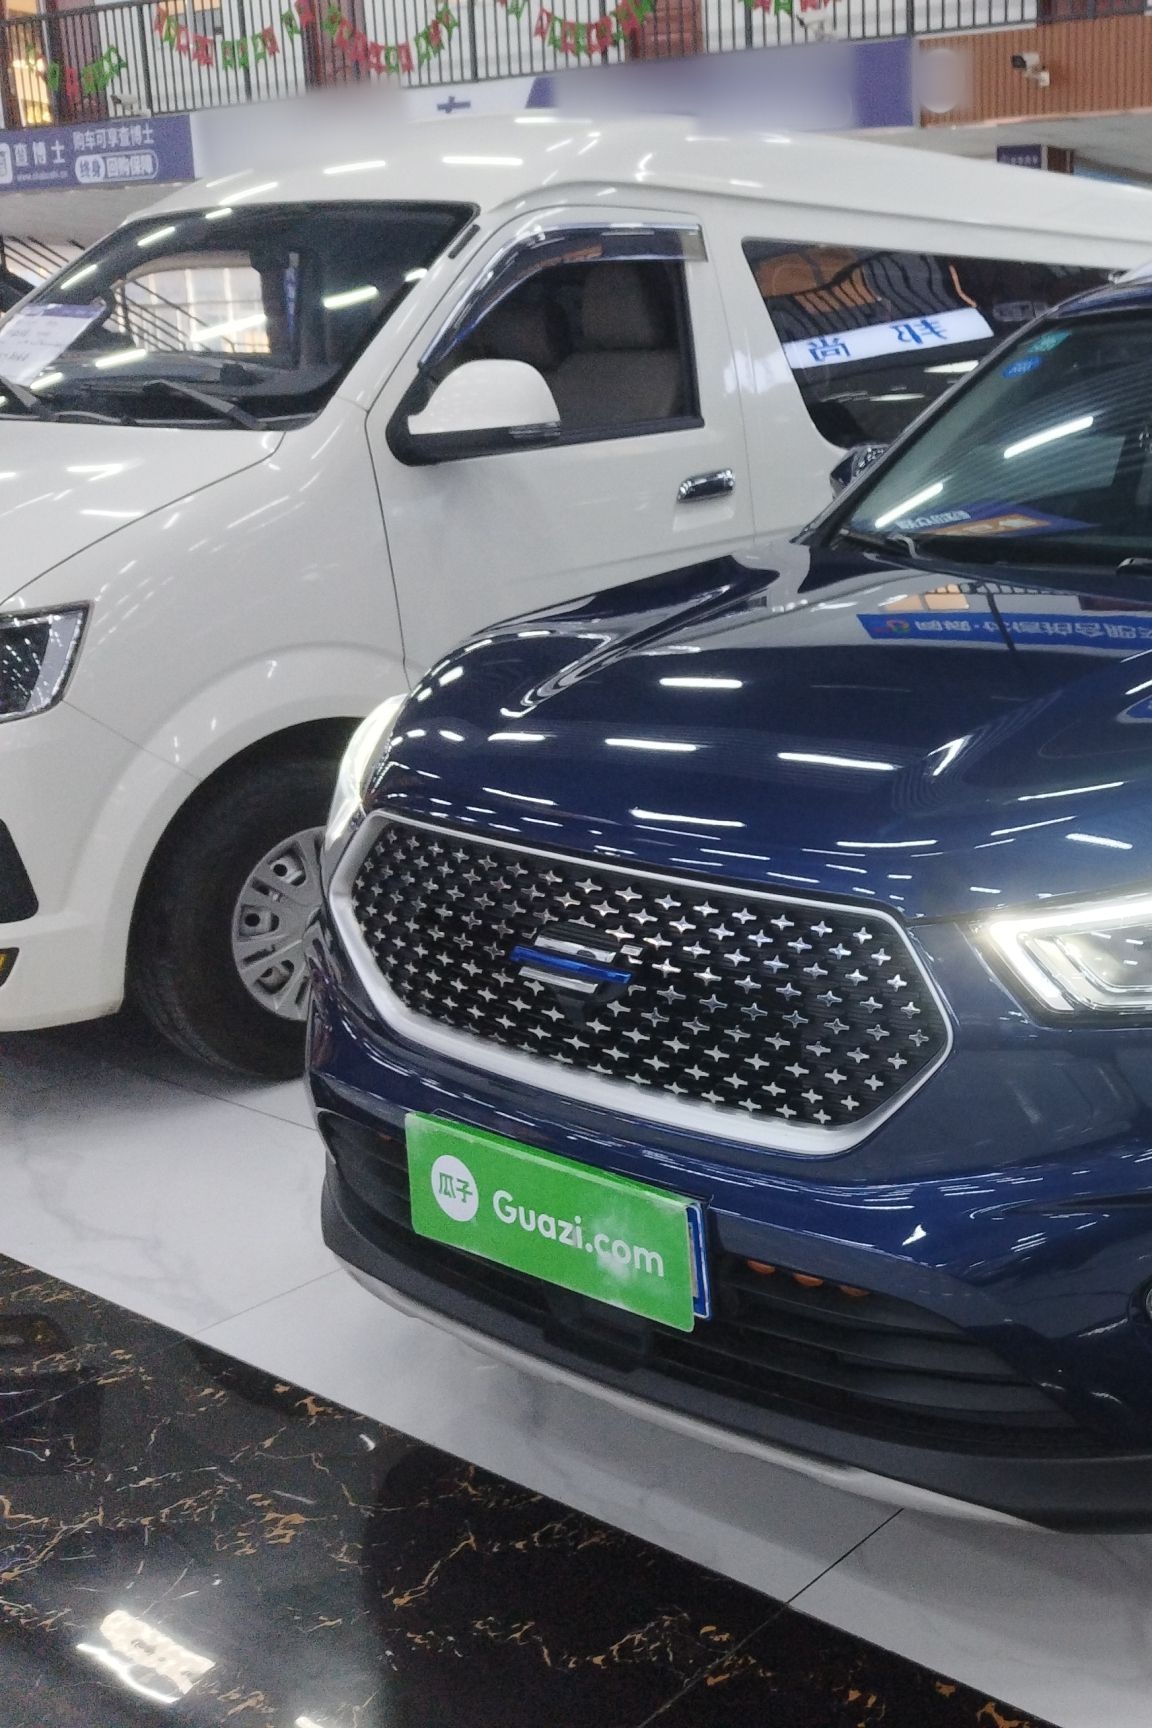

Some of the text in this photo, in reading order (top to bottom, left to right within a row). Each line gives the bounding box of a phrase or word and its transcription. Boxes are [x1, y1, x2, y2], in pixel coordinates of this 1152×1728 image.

[14, 140, 66, 167] 查博士
[438, 1170, 474, 1205] 瓜子
[492, 1189, 665, 1278] Guazi.com
